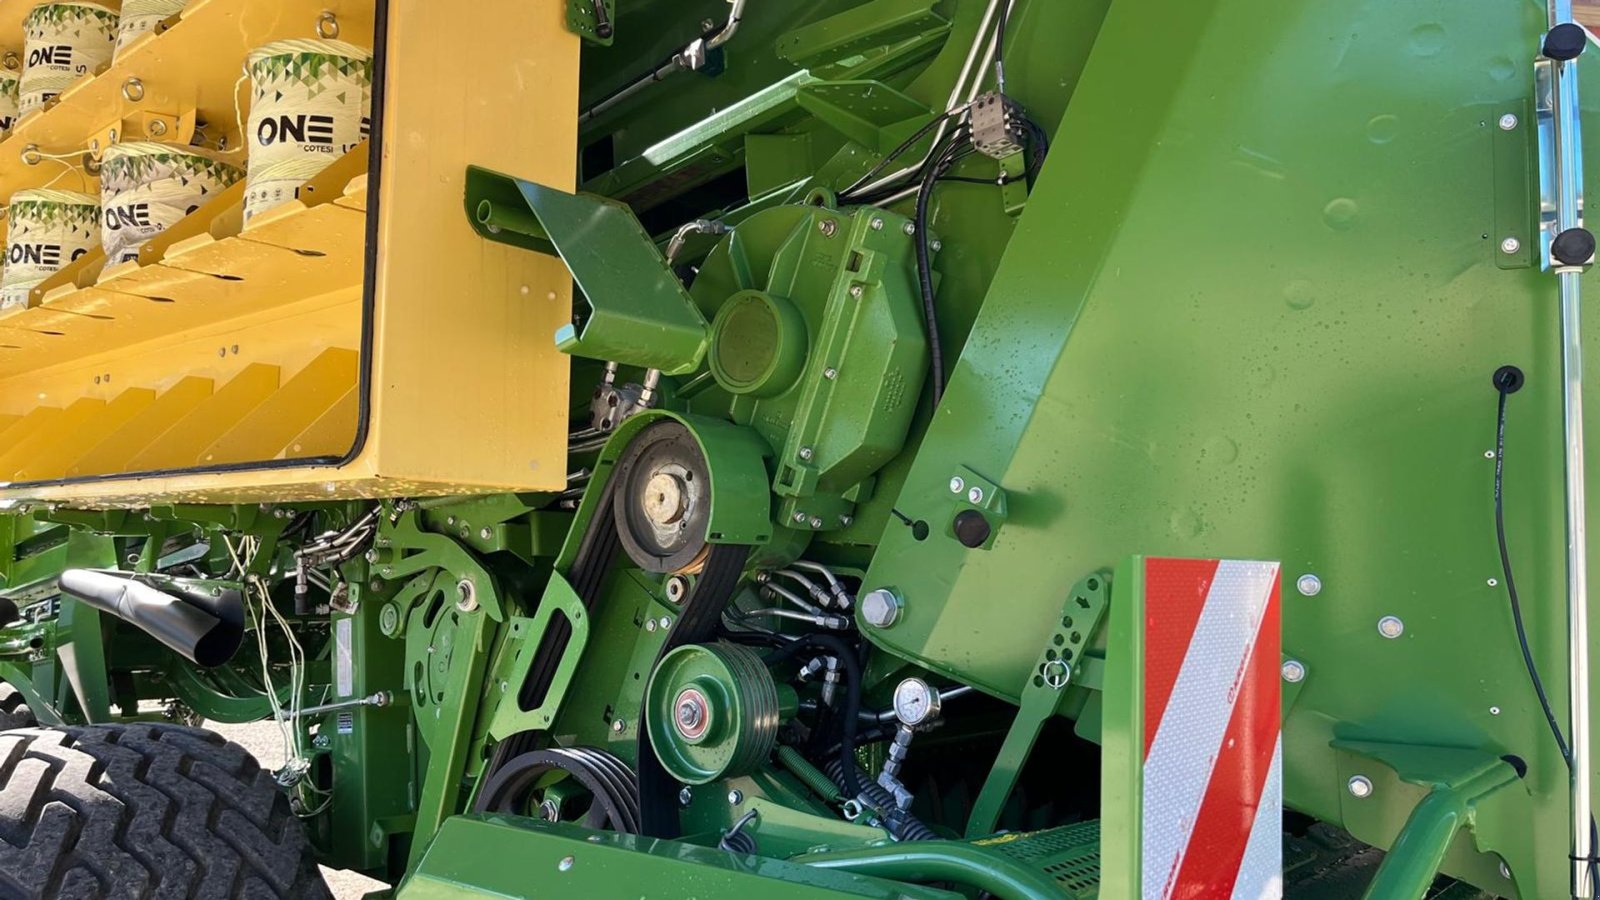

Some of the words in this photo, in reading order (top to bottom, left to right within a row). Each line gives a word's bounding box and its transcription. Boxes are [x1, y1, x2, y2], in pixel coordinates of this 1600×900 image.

[29, 46, 72, 68] ONE
[257, 115, 333, 146] ONE
[304, 145, 333, 153] COTESI
[106, 203, 150, 230] ONE
[11, 243, 61, 264] ONE
